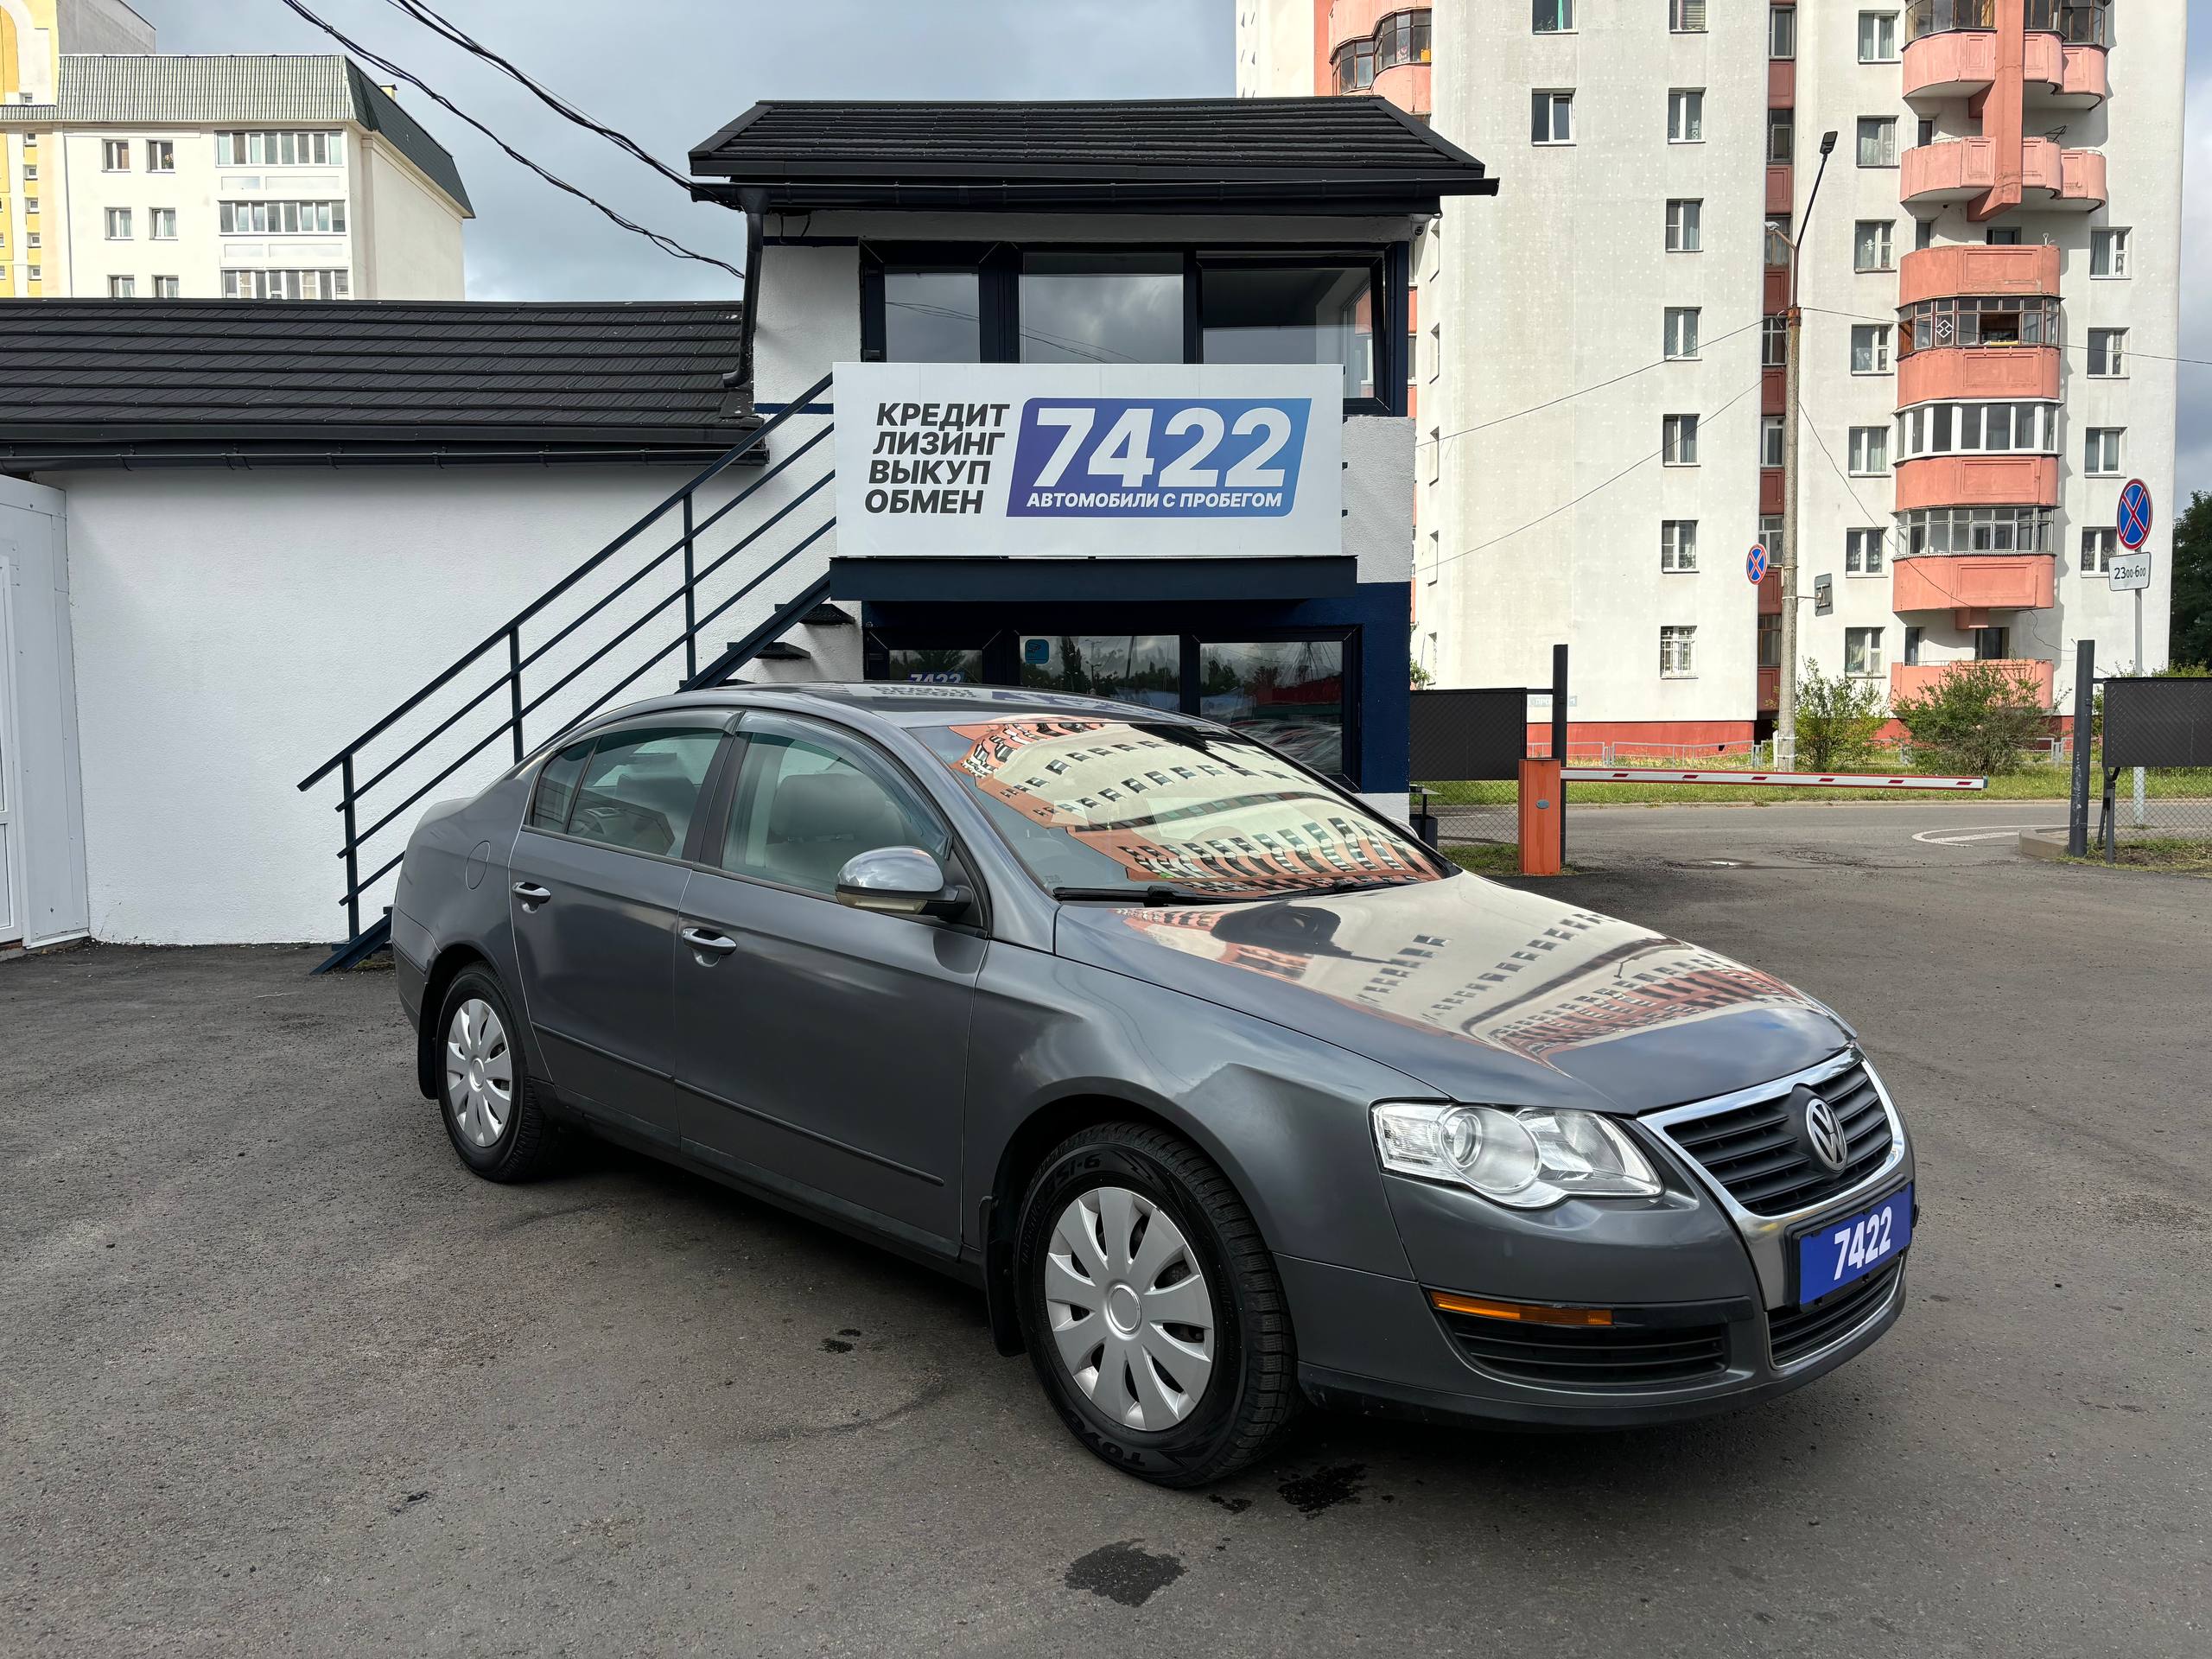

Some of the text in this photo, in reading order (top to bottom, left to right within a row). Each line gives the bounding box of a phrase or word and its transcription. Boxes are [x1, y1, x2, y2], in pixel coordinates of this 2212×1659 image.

[876, 403, 1011, 432] КРЕДИТ
[873, 432, 1006, 455] ЛИЗИНГ
[1033, 407, 1292, 487] 7422
[868, 460, 991, 485] ВЫКУП
[865, 489, 984, 514] ОБМЕН
[1027, 493, 1282, 507] АВТОМОБИЛИ С ПРОБЕГОМ
[1834, 1206, 1892, 1281] 7422
